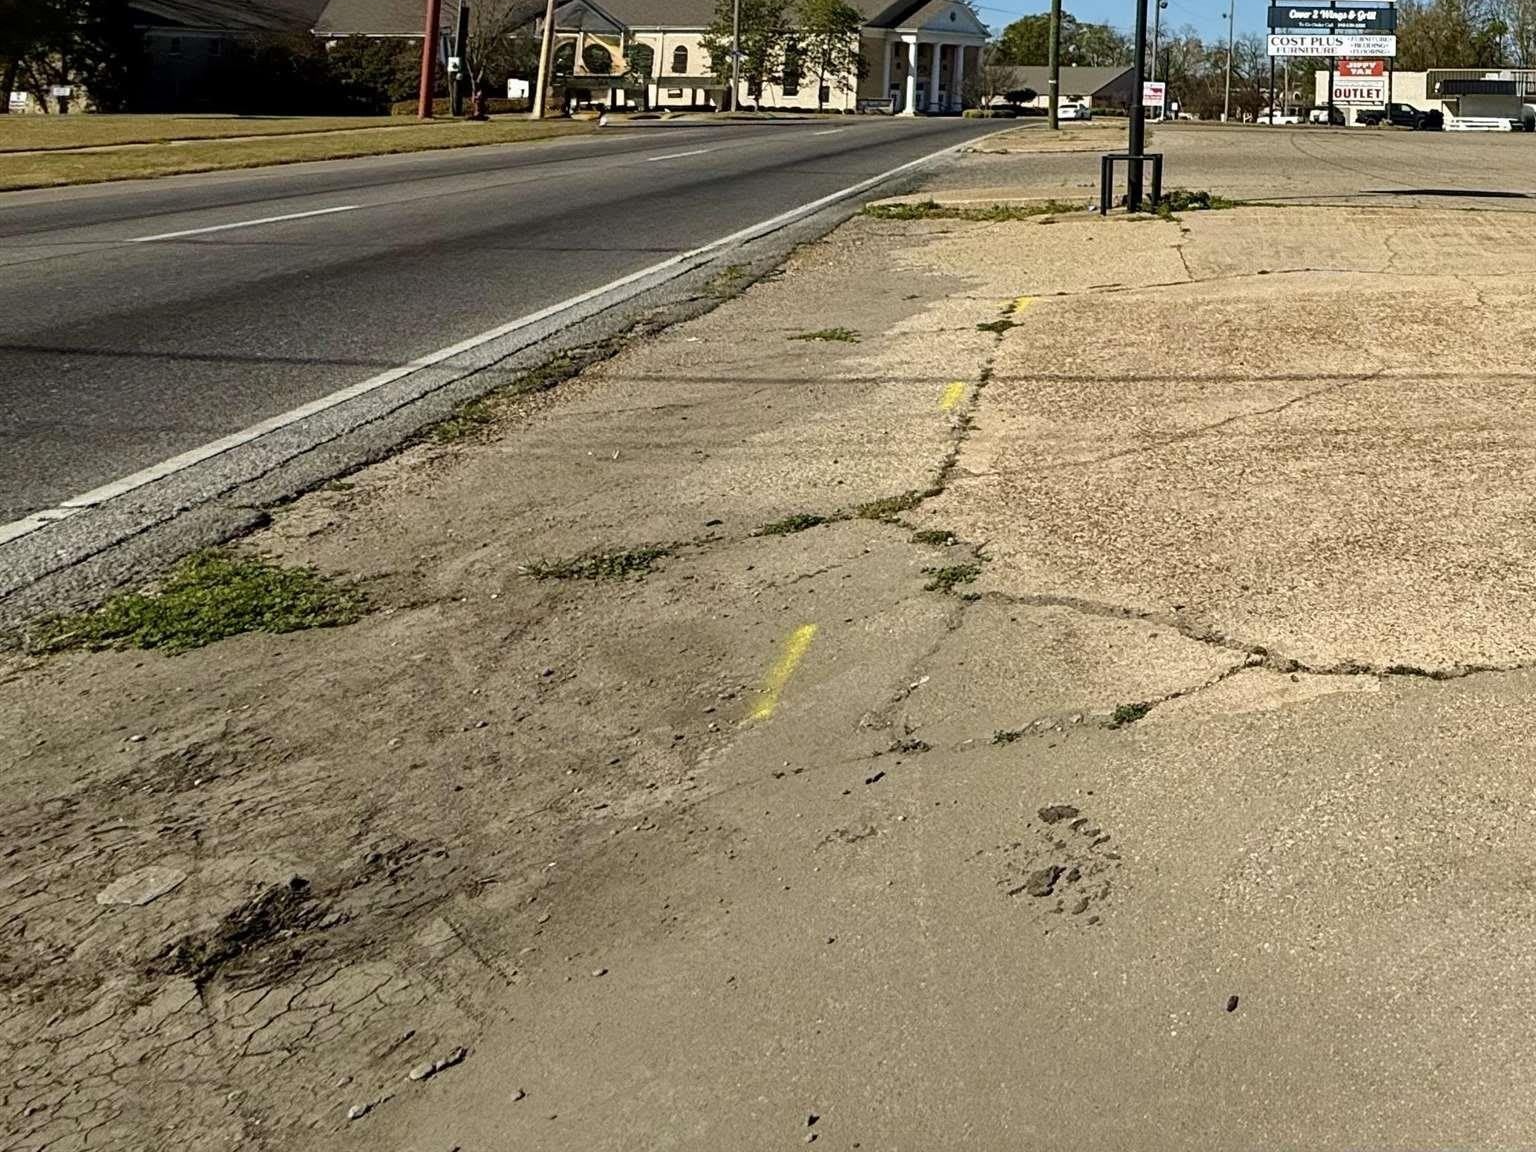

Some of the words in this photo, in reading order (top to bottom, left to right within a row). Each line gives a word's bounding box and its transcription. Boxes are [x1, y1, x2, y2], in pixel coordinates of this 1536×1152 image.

[1270, 36, 1308, 46] COST
[1311, 37, 1344, 46] PLUS
[1334, 88, 1382, 99] OUTLET
